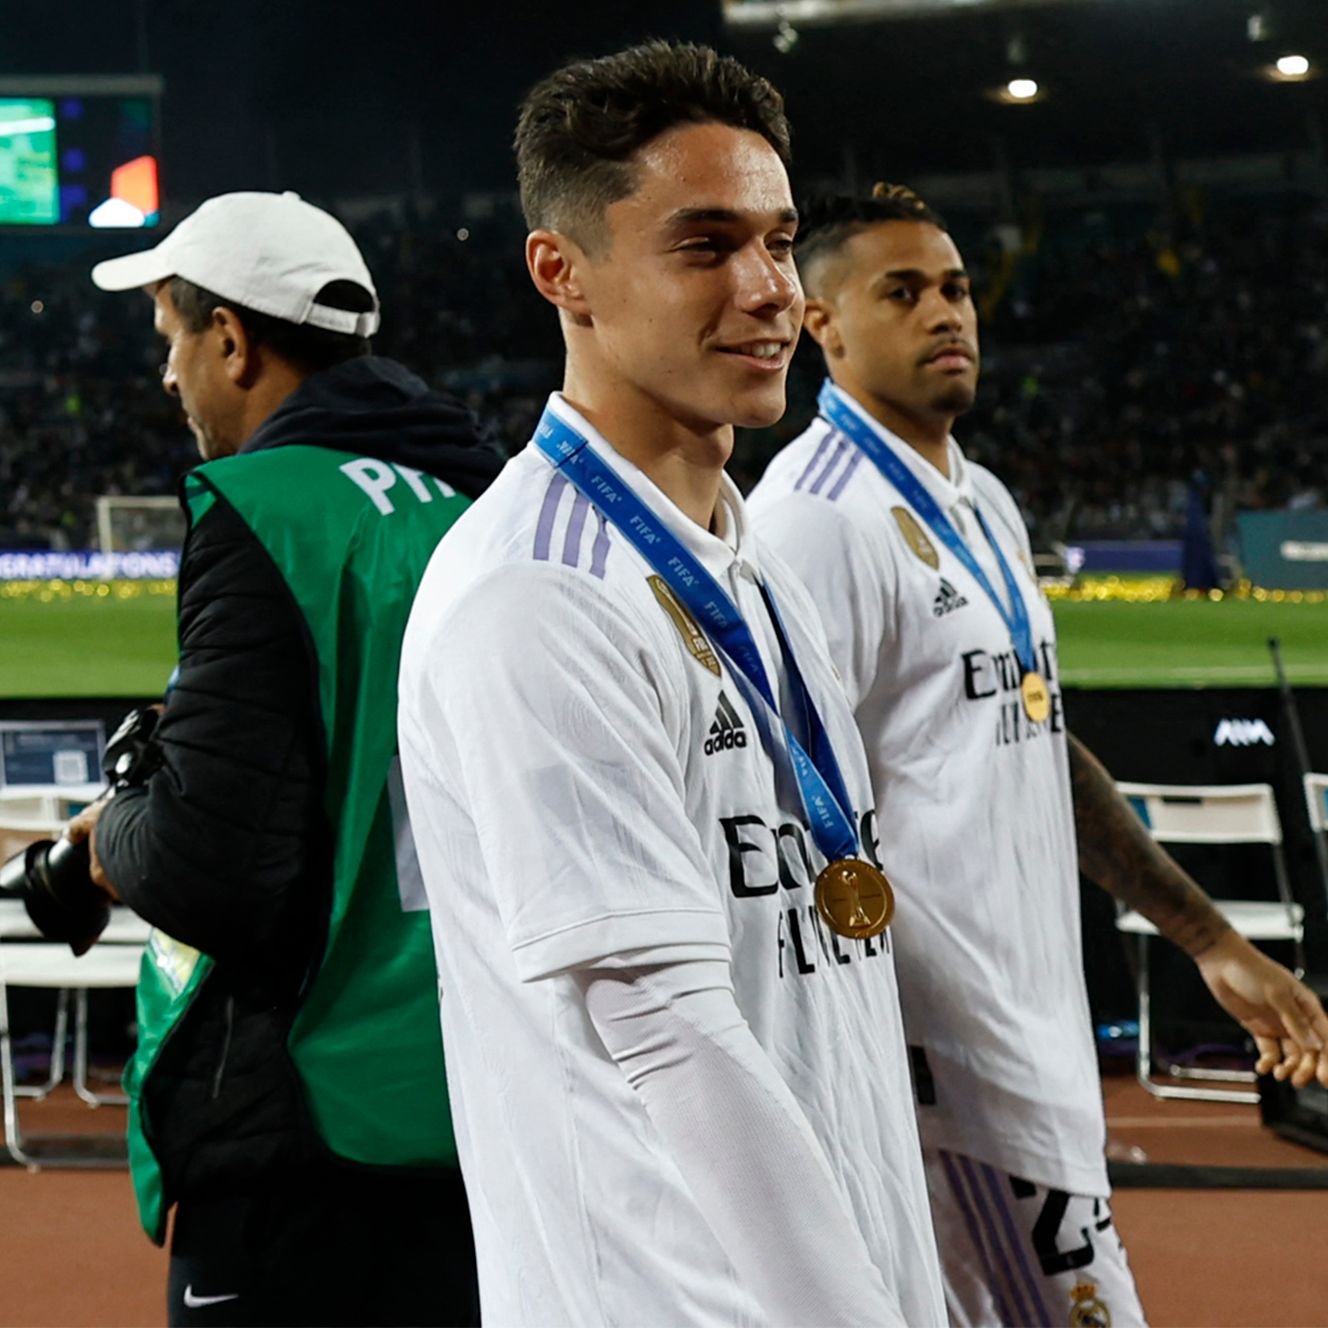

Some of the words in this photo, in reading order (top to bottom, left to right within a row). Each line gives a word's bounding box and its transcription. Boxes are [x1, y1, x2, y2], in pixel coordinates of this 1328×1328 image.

[591, 476, 617, 503] FIFA
[630, 515, 655, 546] FIFA
[668, 556, 694, 587] FIFA
[811, 796, 834, 829] FIFA
